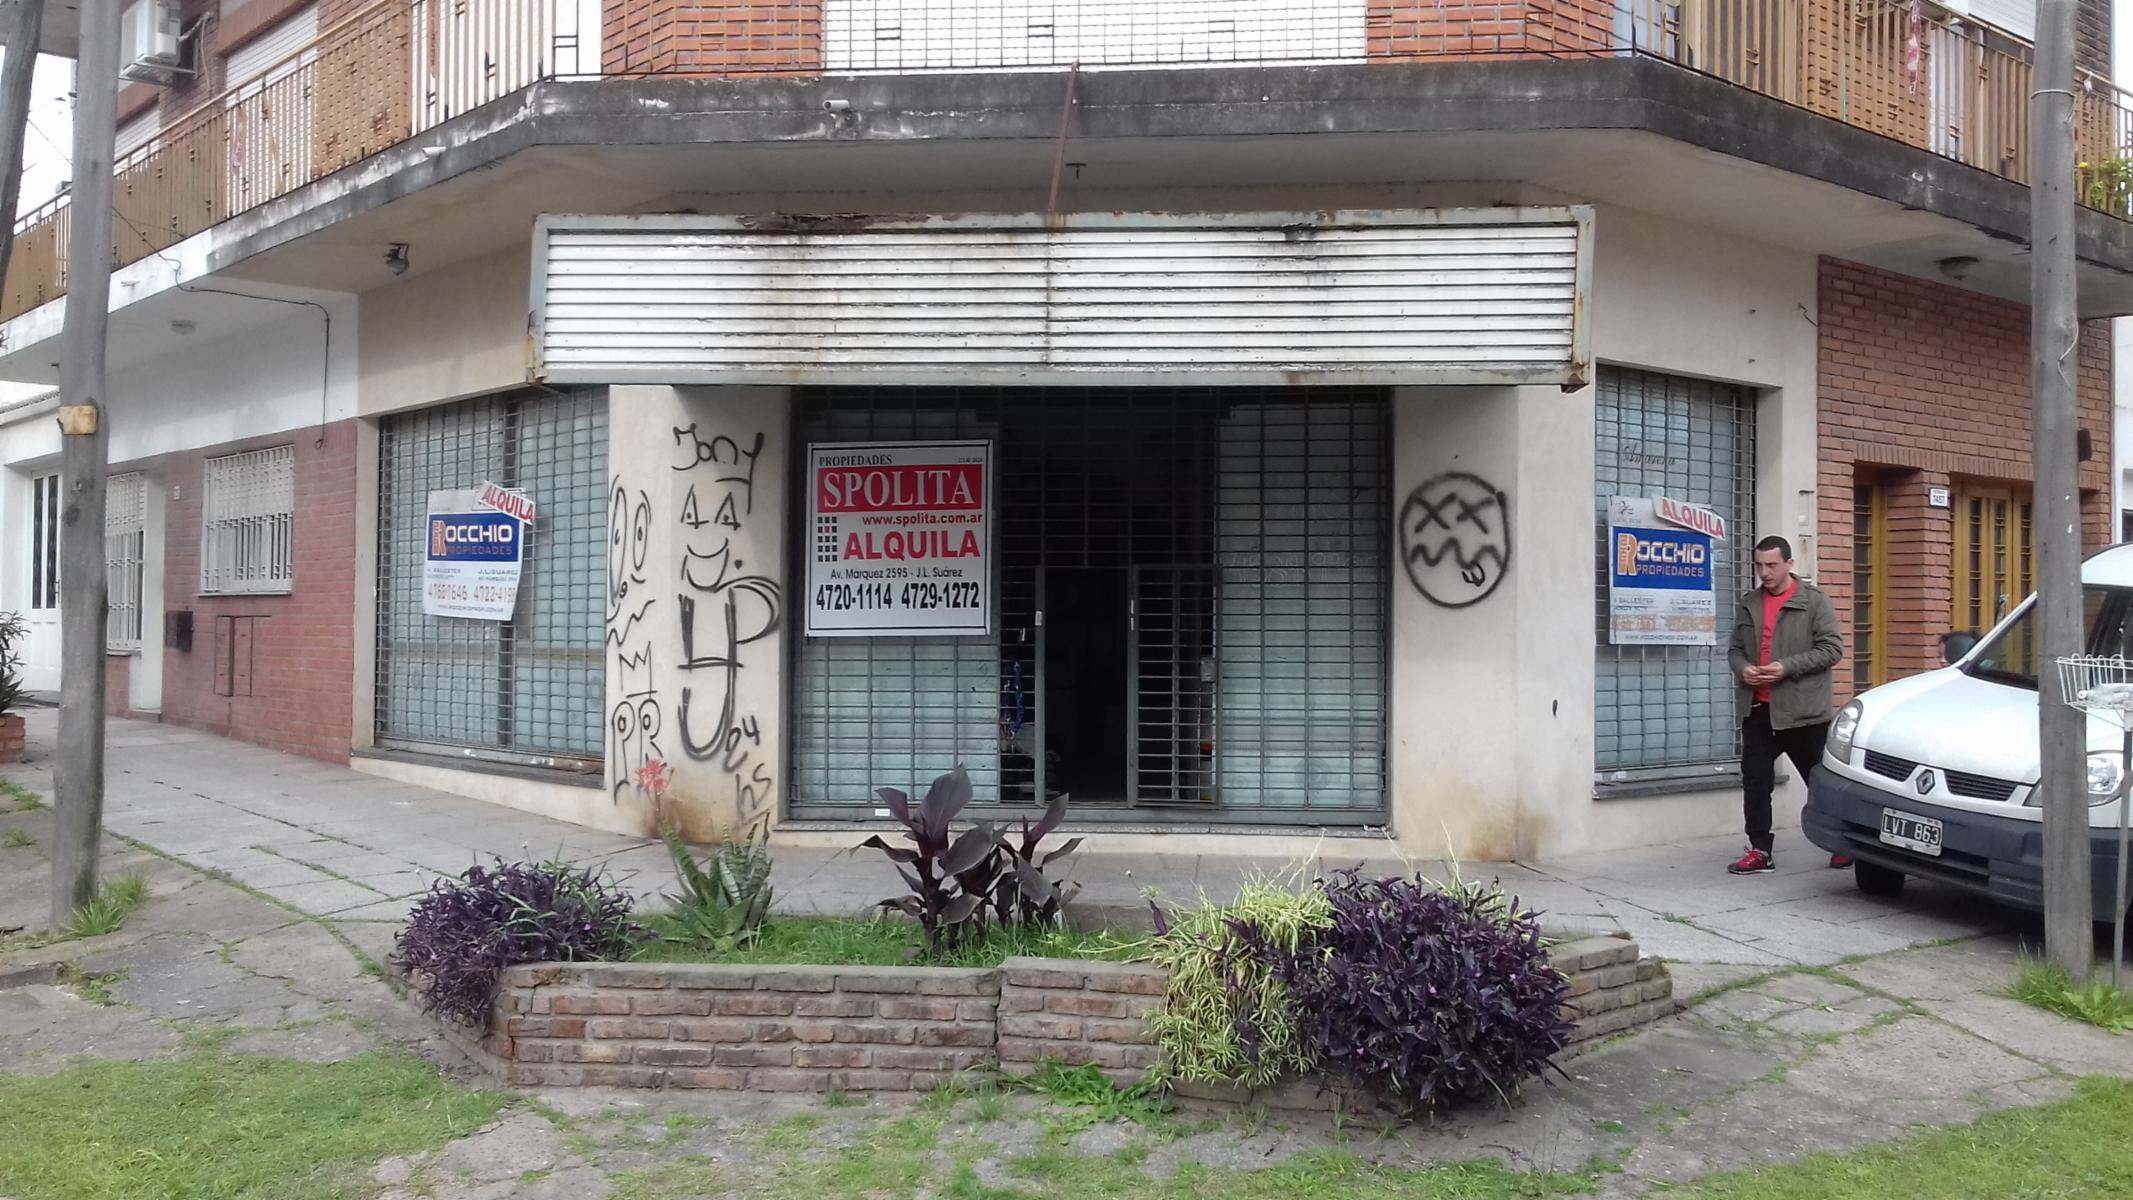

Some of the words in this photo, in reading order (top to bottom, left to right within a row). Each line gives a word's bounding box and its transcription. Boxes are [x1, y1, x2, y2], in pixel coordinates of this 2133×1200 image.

[818, 454, 893, 467] PROPIEDADES
[482, 484, 534, 523] ALQUILA
[823, 470, 975, 508] SPOLITA
[862, 512, 983, 528] www.spolita.com.ar
[1661, 498, 1725, 539] ALQUILA
[431, 519, 513, 557] ROCCHIO
[842, 529, 981, 562] ALQUILA
[1617, 532, 1705, 577] ROCCHIO
[830, 568, 843, 580] Av.
[845, 567, 884, 581] Márquez
[885, 567, 908, 579] 2595
[933, 566, 963, 578] Suárez
[1636, 563, 1705, 578] PROPIEDADES
[816, 582, 893, 611] 4720-1114
[901, 581, 980, 610] 4729-1272
[1883, 815, 1908, 836] LVT
[1914, 823, 1940, 845] 863
